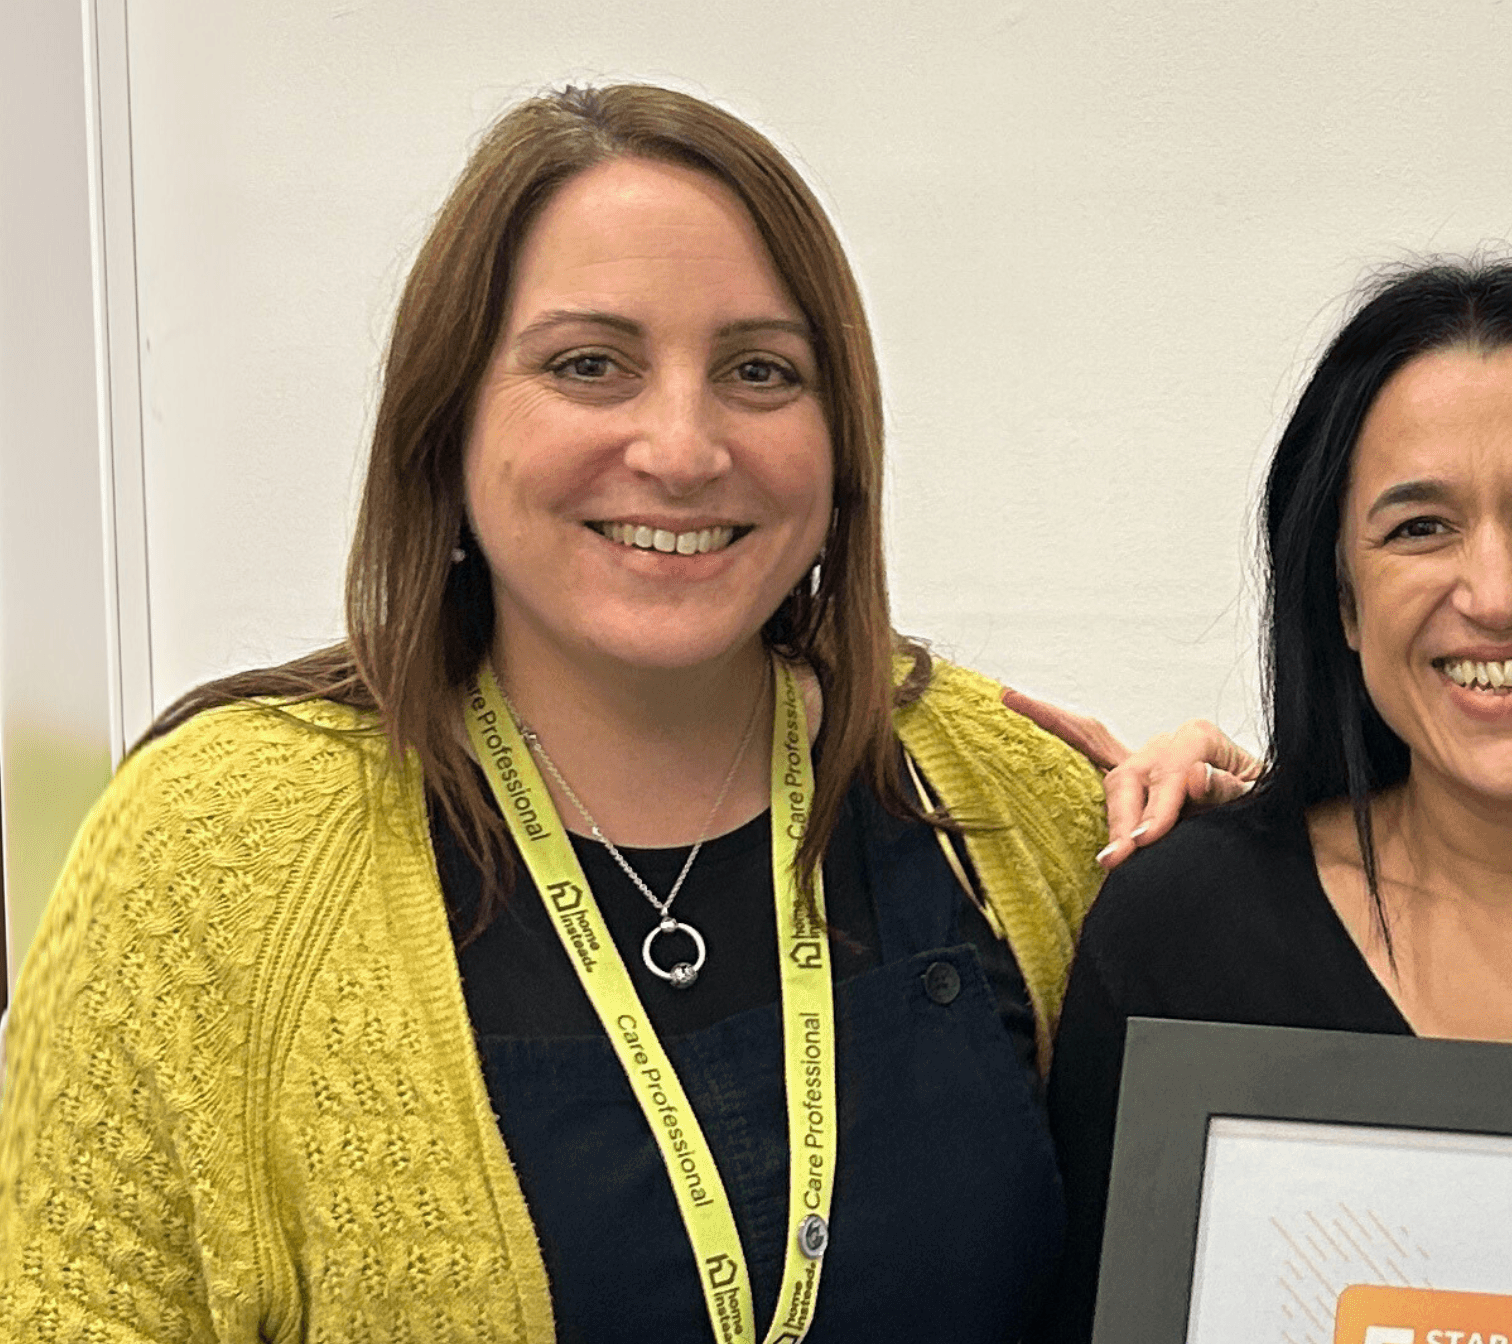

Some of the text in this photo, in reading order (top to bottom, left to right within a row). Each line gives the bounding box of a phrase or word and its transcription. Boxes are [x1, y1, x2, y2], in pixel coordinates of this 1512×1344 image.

[477, 710, 552, 842] Professional
[786, 791, 805, 841] Care
[574, 909, 600, 951] home
[617, 1014, 714, 1207] Care Professional
[798, 1012, 824, 1210] Care Professional
[727, 1287, 743, 1336] home
[783, 1281, 803, 1330] home
